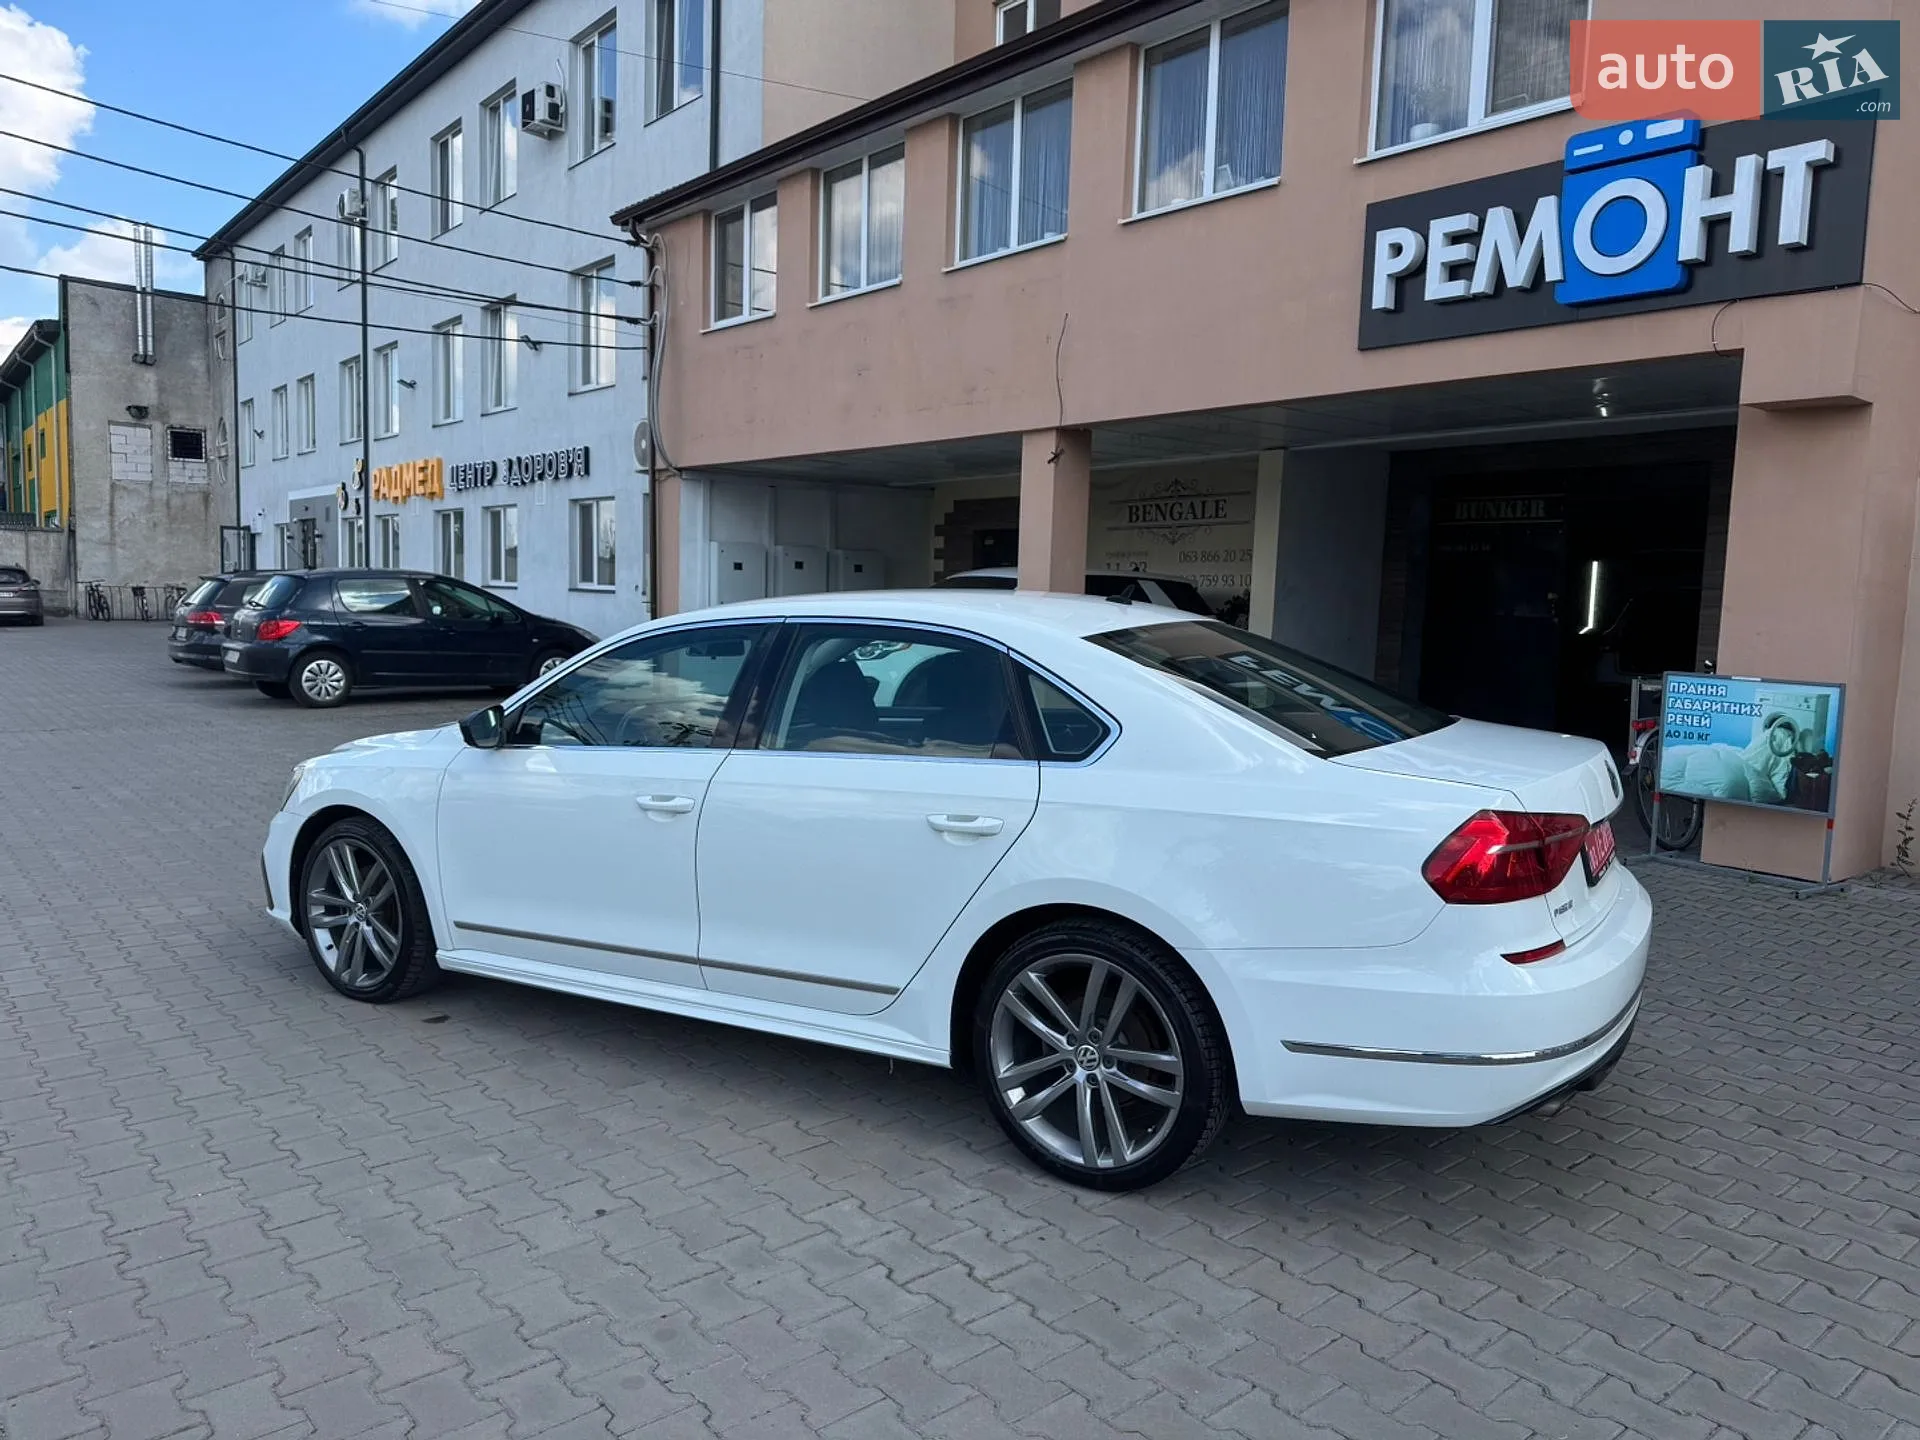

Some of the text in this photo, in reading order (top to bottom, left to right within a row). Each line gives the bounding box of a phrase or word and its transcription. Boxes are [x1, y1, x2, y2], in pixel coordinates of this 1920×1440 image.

[1372, 138, 1834, 310] РЕМОНТ
[371, 457, 445, 504] РАДМЕД
[449, 460, 497, 492] ЦЕНТР
[1127, 499, 1227, 523] BENGALE
[1455, 500, 1547, 519] BUNKER
[1223, 549, 1236, 562] 20
[1222, 574, 1235, 587] 93
[1669, 682, 1727, 697] ПРАННЯ
[1668, 697, 1763, 716] ГАБАРИТНИХ
[1667, 713, 1711, 728] РЕЧЕЙ
[1683, 731, 1695, 740] 10
